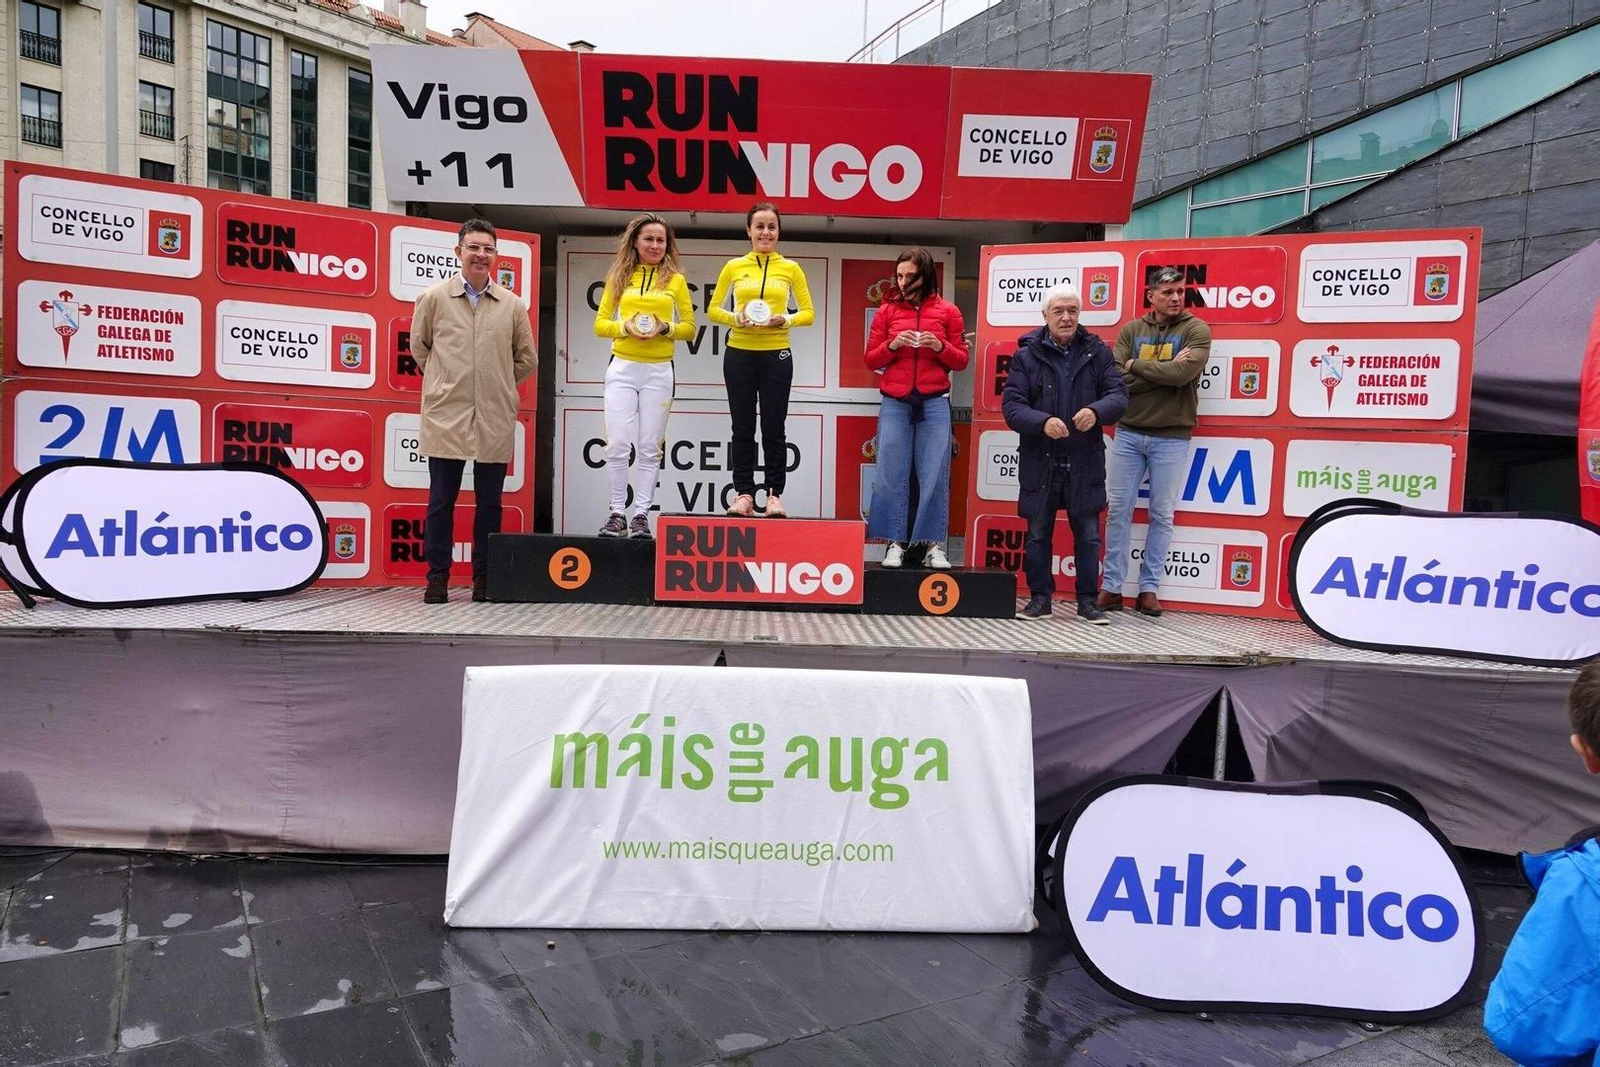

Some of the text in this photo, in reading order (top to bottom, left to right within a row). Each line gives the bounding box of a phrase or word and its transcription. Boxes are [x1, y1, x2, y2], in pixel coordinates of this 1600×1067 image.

[387, 81, 529, 131] Vigo
[602, 70, 759, 133] RUN
[969, 127, 1068, 147] CONCELLO
[979, 148, 1054, 165] DE VIGO
[407, 151, 515, 189] +11
[40, 205, 135, 229] CONCELLO
[52, 222, 125, 243] DE VIGO
[226, 219, 296, 249] RUN
[408, 252, 462, 268] CONCEL
[416, 266, 459, 280] DE VI
[1312, 267, 1402, 283] CONCELLO
[1006, 292, 1024, 303] DE
[1321, 283, 1390, 297] DE VIGO
[97, 303, 185, 325] FEDERACIÓN
[97, 324, 152, 342] GALEGA
[154, 326, 172, 343] DE
[230, 326, 319, 346] CONCELLO
[97, 344, 175, 363] ATLETISMO
[241, 342, 309, 360] DE VIGO
[1359, 353, 1441, 370] FEDERACIÓN
[1358, 374, 1427, 388] GALEGA DE
[1356, 392, 1429, 407] ATLETISMO
[224, 419, 293, 444] RUN
[1000, 466, 1016, 477] DE
[1296, 466, 1438, 499] máis que auga
[44, 509, 314, 560] Atlántico
[391, 519, 427, 540] RU
[987, 528, 1028, 550] RU
[665, 525, 756, 558] RUN
[560, 554, 579, 582] 2
[1164, 565, 1200, 577] VIGO
[930, 580, 948, 607] 3
[1310, 555, 1600, 618] Atlántico
[549, 712, 950, 810] máis que auga
[603, 836, 895, 866] www.maisqueauga.com
[1085, 853, 1460, 943] Atlántico
